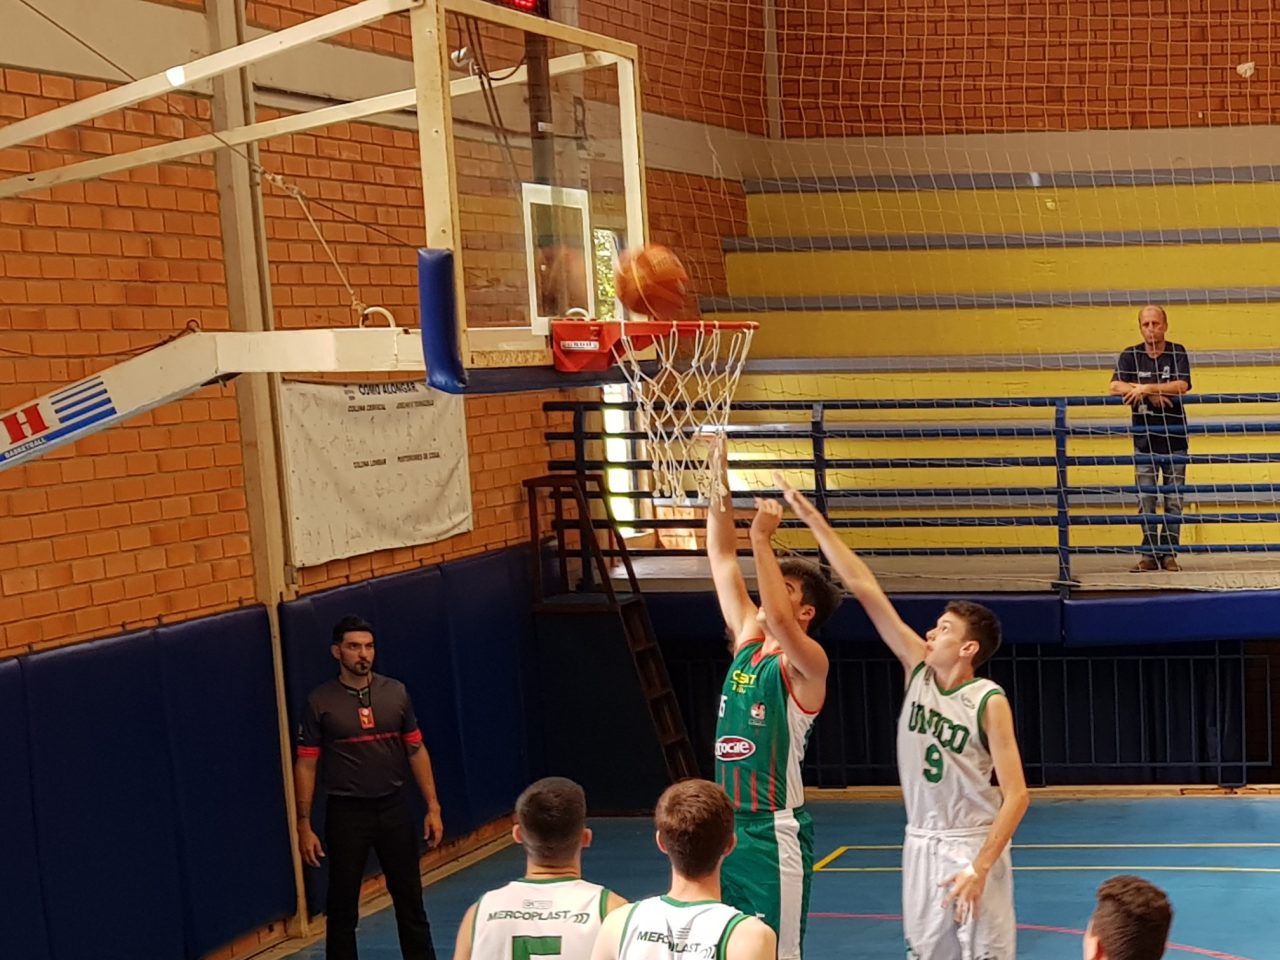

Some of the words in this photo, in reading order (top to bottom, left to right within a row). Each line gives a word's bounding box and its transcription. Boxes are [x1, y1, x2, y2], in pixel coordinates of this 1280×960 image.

[0, 403, 49, 445] H
[4, 437, 47, 459] BASKETBALL
[923, 743, 944, 783] 9
[487, 910, 571, 921] MERCOPLAST
